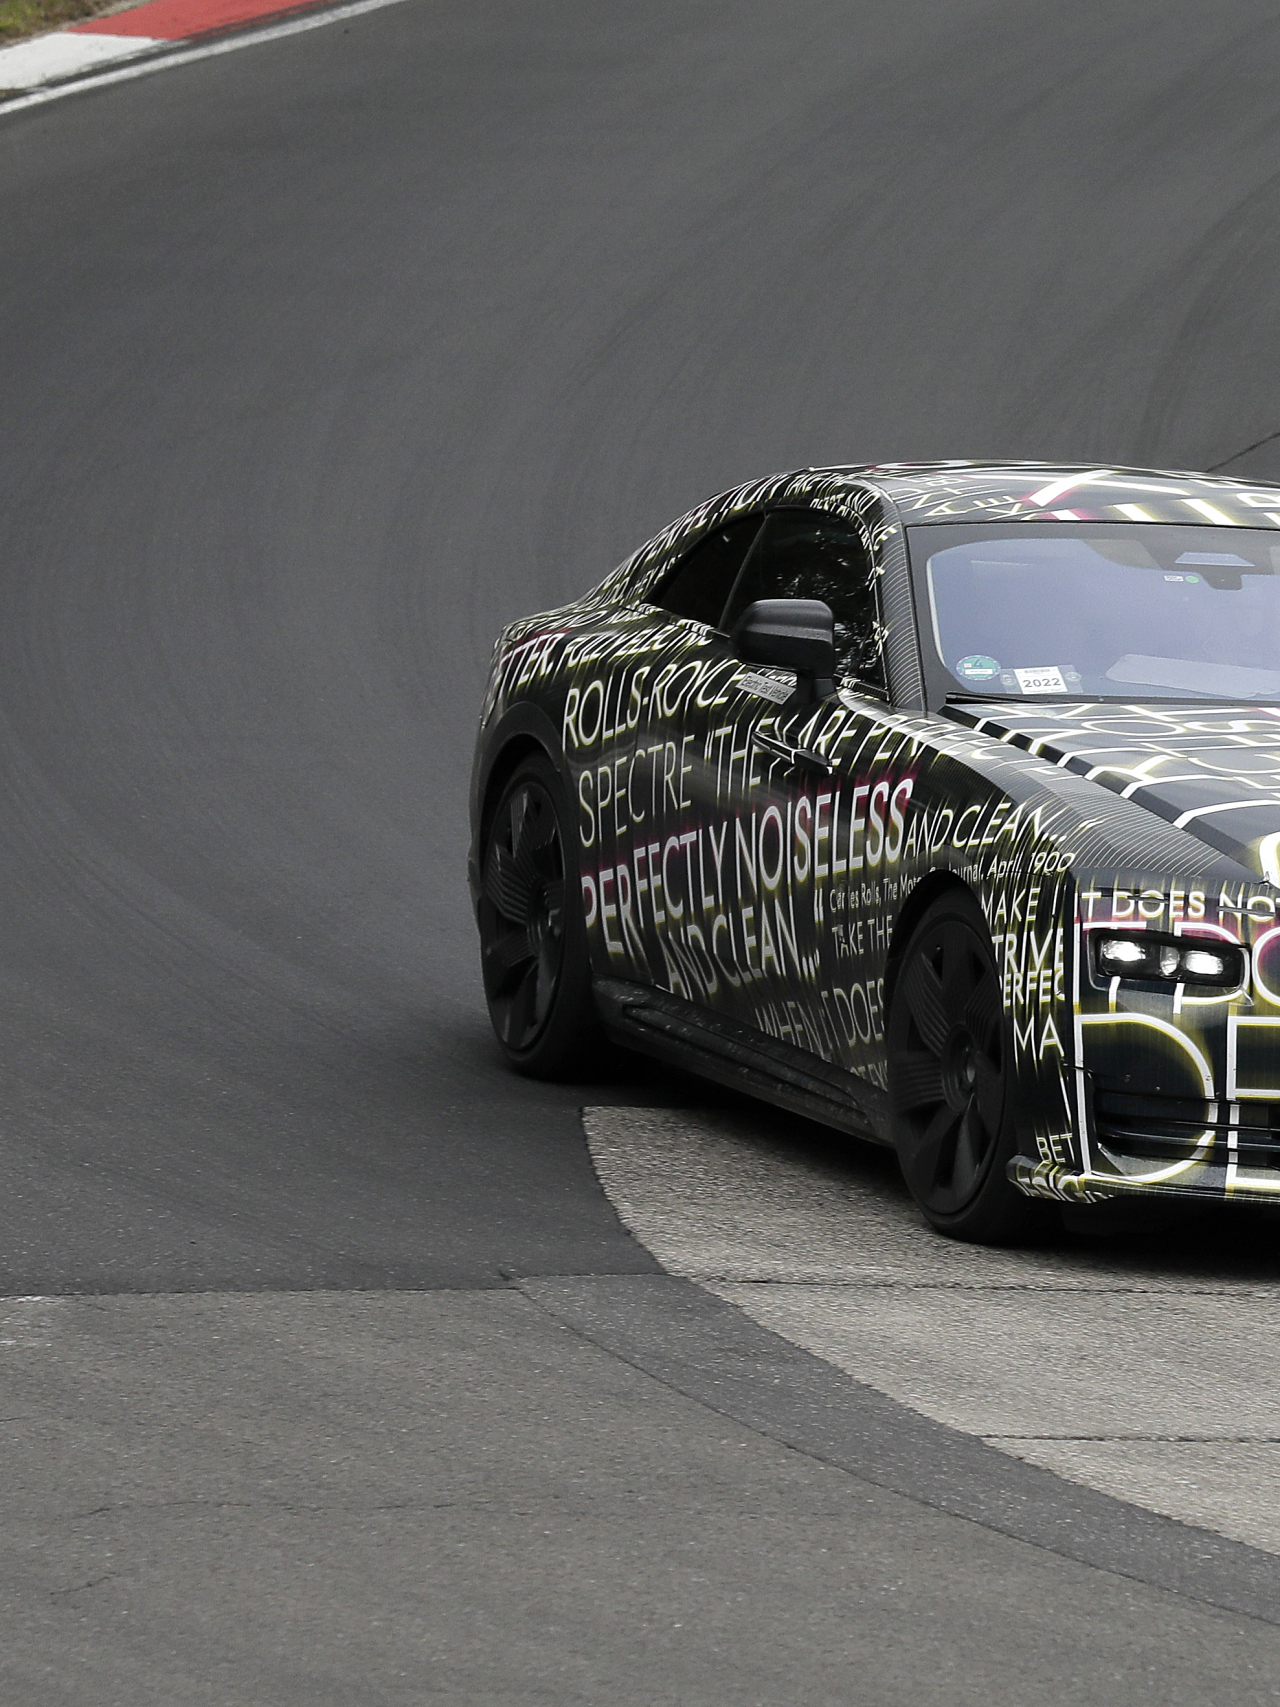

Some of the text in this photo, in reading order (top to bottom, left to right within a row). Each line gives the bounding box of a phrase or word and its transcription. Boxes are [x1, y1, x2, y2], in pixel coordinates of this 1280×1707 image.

[562, 658, 747, 752] ROLLS-ROYCE
[1023, 678, 1061, 688] 2022
[579, 734, 694, 848] SPECTRE
[904, 808, 953, 860] AND
[581, 777, 914, 958] PERFECTLY NOISELESS
[883, 877, 898, 902] The
[1027, 851, 1076, 876] 1900
[832, 921, 865, 959] TAKE
[981, 886, 1041, 929] MAKE
[1074, 890, 1102, 918] IT
[1111, 890, 1206, 919] DOES
[991, 927, 1064, 974] TRIVE
[999, 968, 1066, 1007] ERFEC
